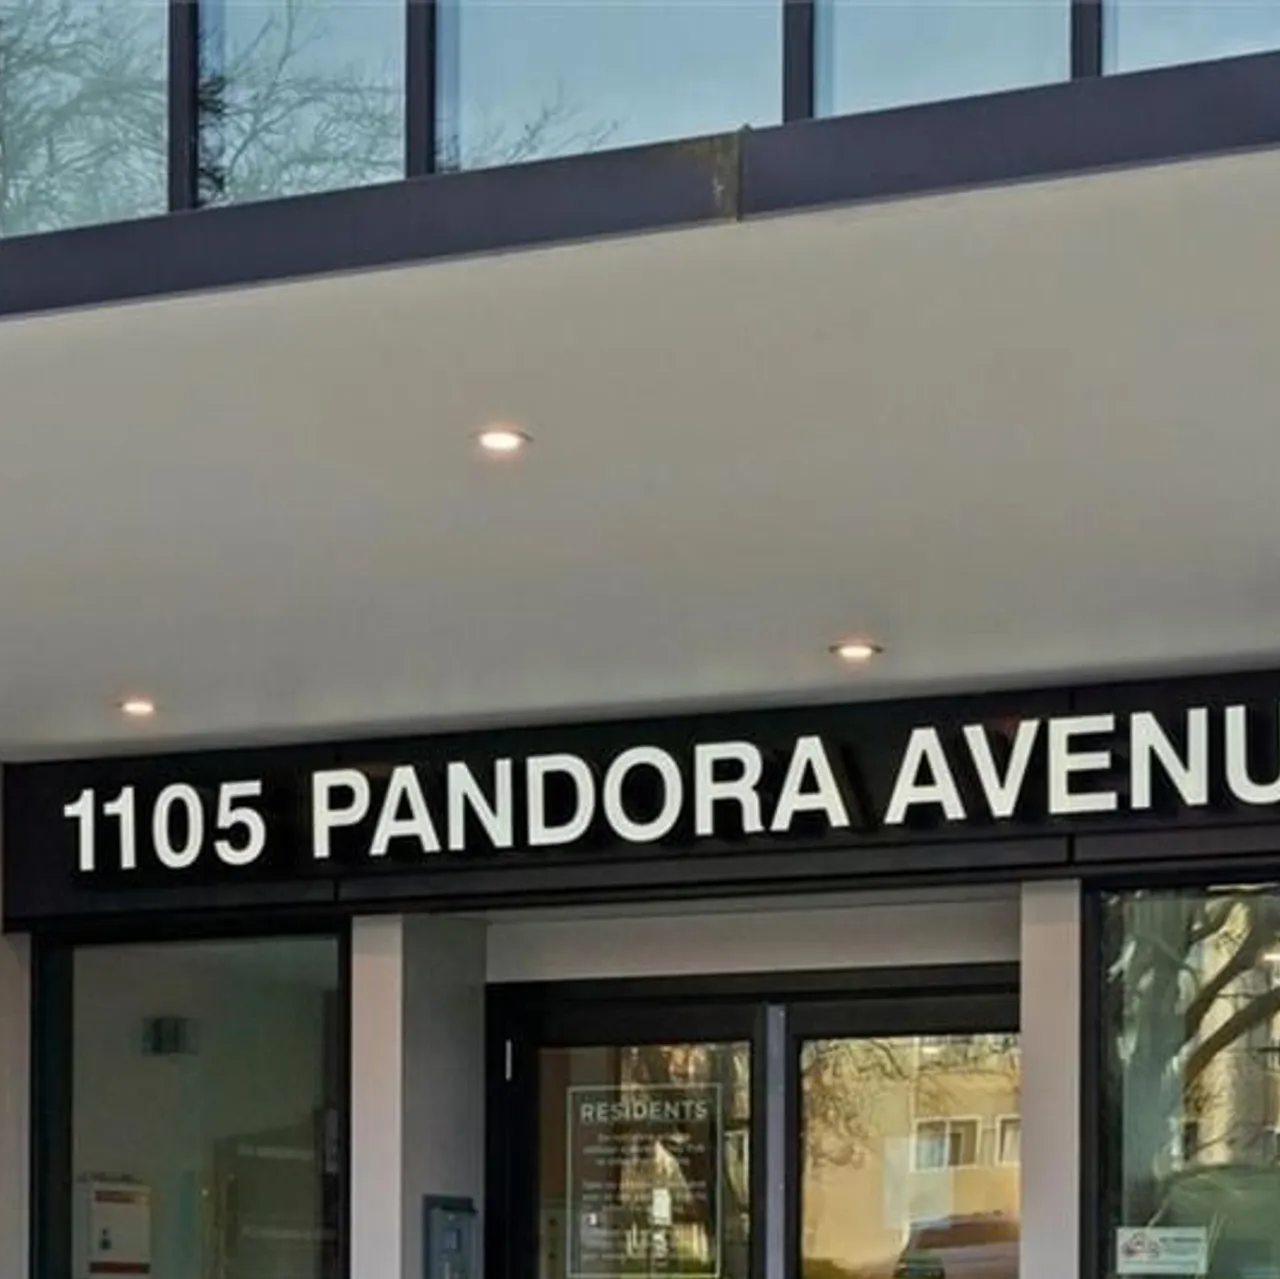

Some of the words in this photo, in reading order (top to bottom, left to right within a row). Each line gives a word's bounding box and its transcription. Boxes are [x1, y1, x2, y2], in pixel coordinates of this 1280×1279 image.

[61, 778, 267, 872] 1105
[311, 735, 850, 860] PANDORA
[579, 1100, 708, 1124] RESIDENTS
